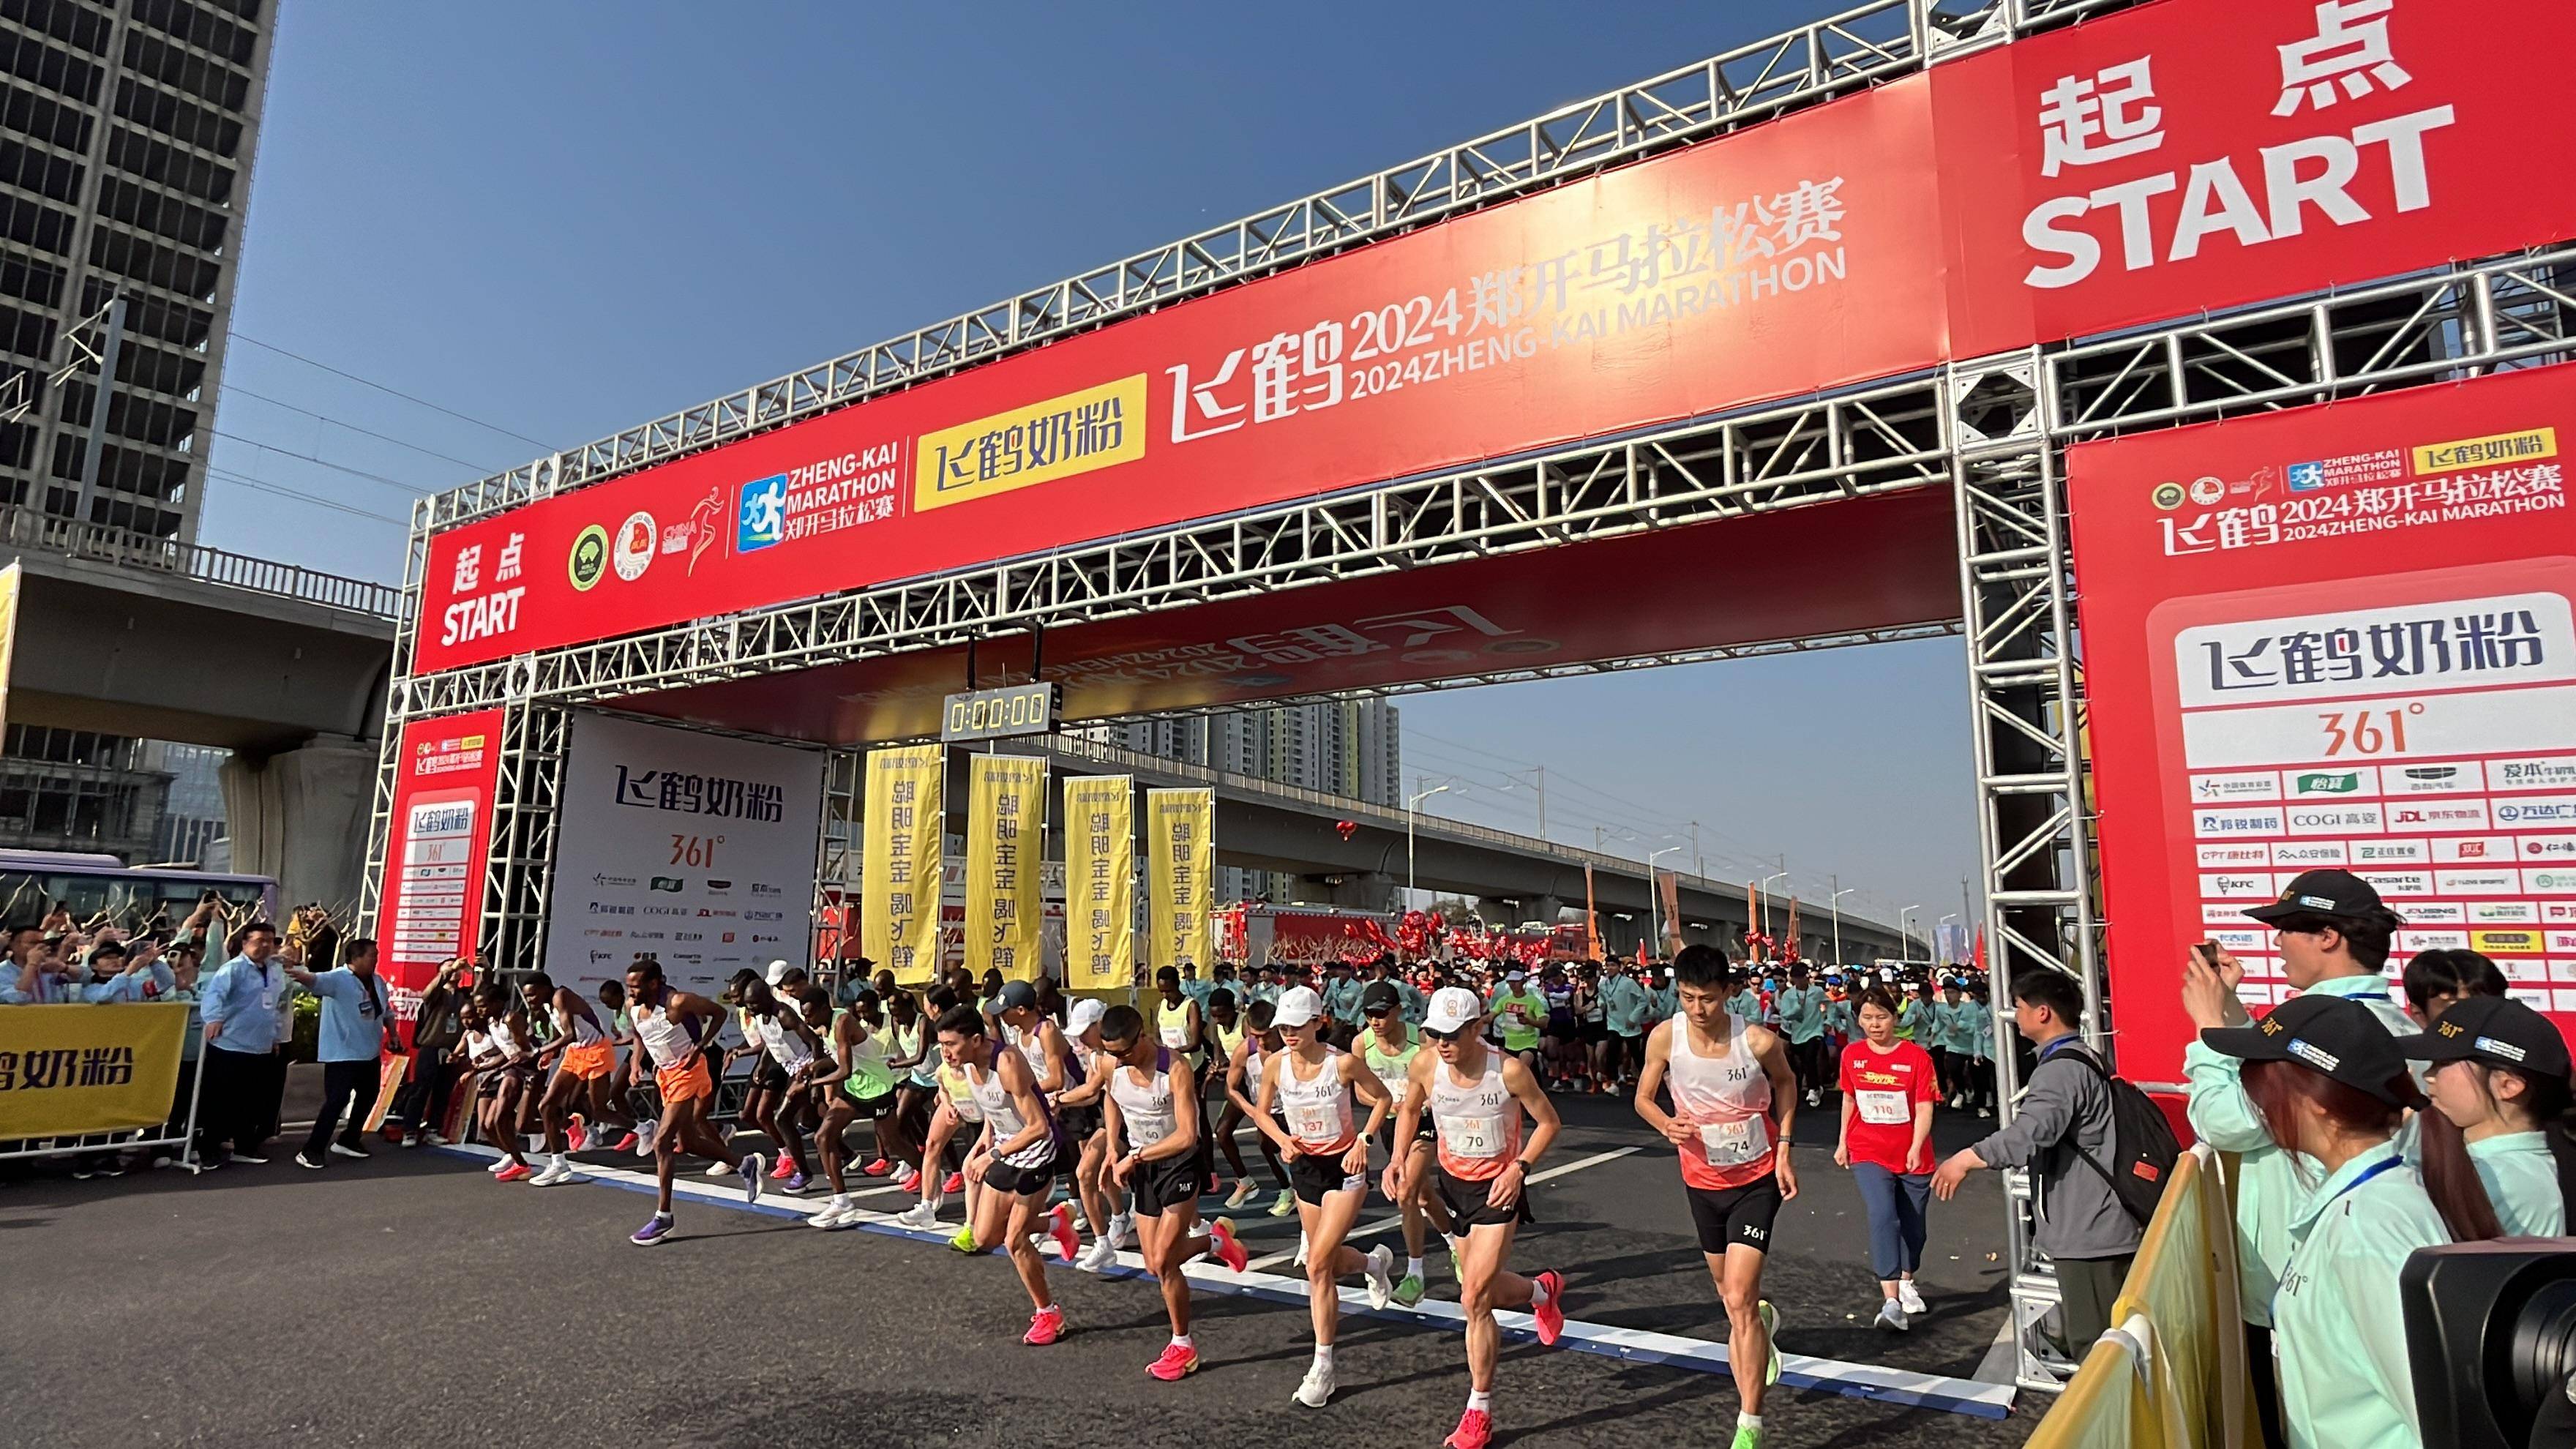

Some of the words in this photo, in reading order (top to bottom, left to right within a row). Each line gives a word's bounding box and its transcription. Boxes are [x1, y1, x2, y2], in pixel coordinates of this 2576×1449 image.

[2023, 103, 2455, 288] START
[1350, 176, 1847, 362] 2024郑开马拉松赛
[1350, 309, 1608, 400] 2024ZHENG-KAI
[1617, 246, 1846, 333] MARATHON
[1166, 320, 1342, 443] 飞鹤
[936, 396, 1123, 492] 飞鹤奶粉
[2324, 449, 2400, 469] ZHENG-KAI
[2426, 435, 2543, 468] 飞鹤奶粉
[789, 441, 897, 490] ZHENG-KAI
[2324, 460, 2401, 477] MARATHON
[787, 468, 896, 514] MARATHON
[2280, 464, 2562, 525] 2024郑开马拉松赛
[785, 495, 894, 541] 郑开马拉松赛
[2156, 503, 2280, 557] 飞鹤
[2282, 509, 2438, 542] 2024ZHENG-KAI
[2443, 493, 2565, 522] MARATHON
[441, 586, 525, 645] START
[2200, 610, 2544, 690] 飞鹤奶粉
[950, 693, 1045, 732] 0:00:00
[2318, 702, 2425, 757] 361°
[615, 765, 784, 823] 飞鹤奶粉
[414, 808, 468, 833] 飞鹤奶粉
[2294, 814, 2341, 826] COGI
[2345, 812, 2377, 825] 高姿
[2394, 811, 2427, 823] JDL
[2428, 809, 2481, 820] 京东物流
[670, 834, 725, 869] 361°
[2231, 880, 2254, 888] KFC
[1727, 1064, 1750, 1081] 361°
[1480, 1090, 1502, 1106] 361°
[1873, 1105, 1893, 1115] 110
[1145, 1131, 1159, 1139] 60
[1303, 1121, 1323, 1131] 137
[1466, 1137, 1483, 1147] 70
[1730, 1140, 1750, 1153] 74
